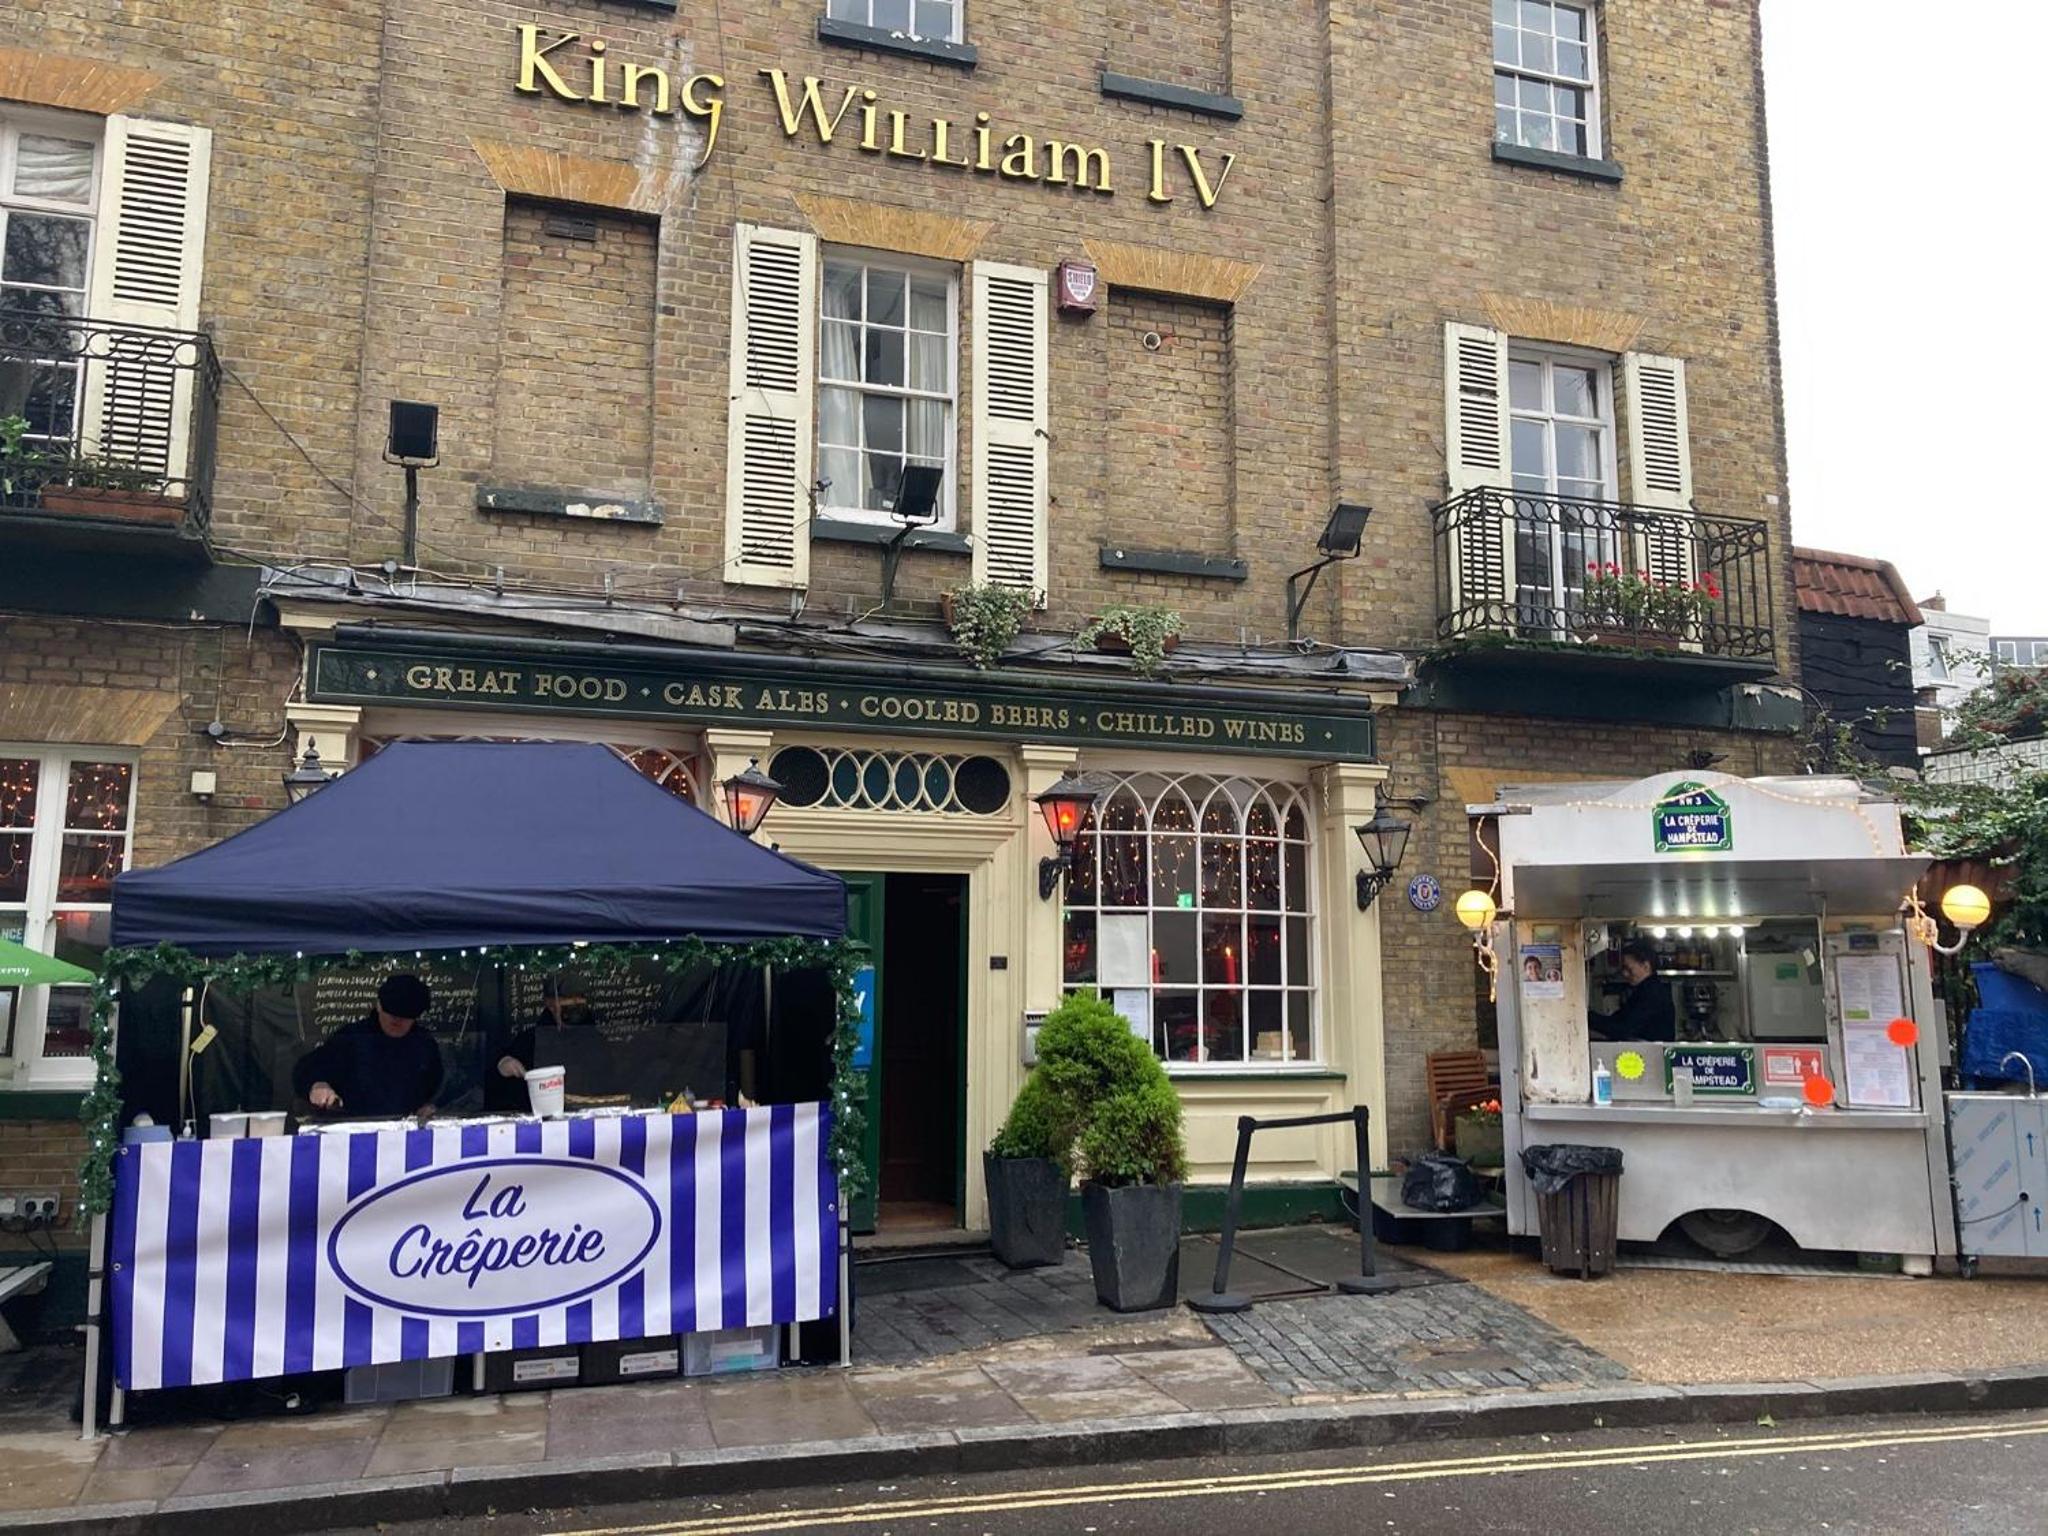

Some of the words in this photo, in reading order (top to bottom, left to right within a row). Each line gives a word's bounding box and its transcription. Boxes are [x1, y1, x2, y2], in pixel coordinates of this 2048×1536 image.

[514, 24, 725, 170] King
[1148, 138, 1236, 208] IV
[406, 665, 521, 693] GREAT
[534, 674, 627, 701] FOOD
[664, 683, 743, 710] CASK
[755, 689, 829, 714] ALES
[860, 696, 980, 723] COOLED
[990, 704, 1069, 729] BEERS
[1097, 711, 1215, 737] CHILLED
[1223, 719, 1305, 743] WINES
[1664, 816, 1676, 827] LA
[1687, 825, 1697, 833] DE
[1667, 832, 1719, 843] HAMPSTEAD
[1681, 1056, 1693, 1066] LA
[1696, 1055, 1736, 1067] CRÊPERIE
[1704, 1066, 1714, 1074] DE
[462, 1173, 526, 1220] La
[389, 1224, 606, 1289] Crêperie
